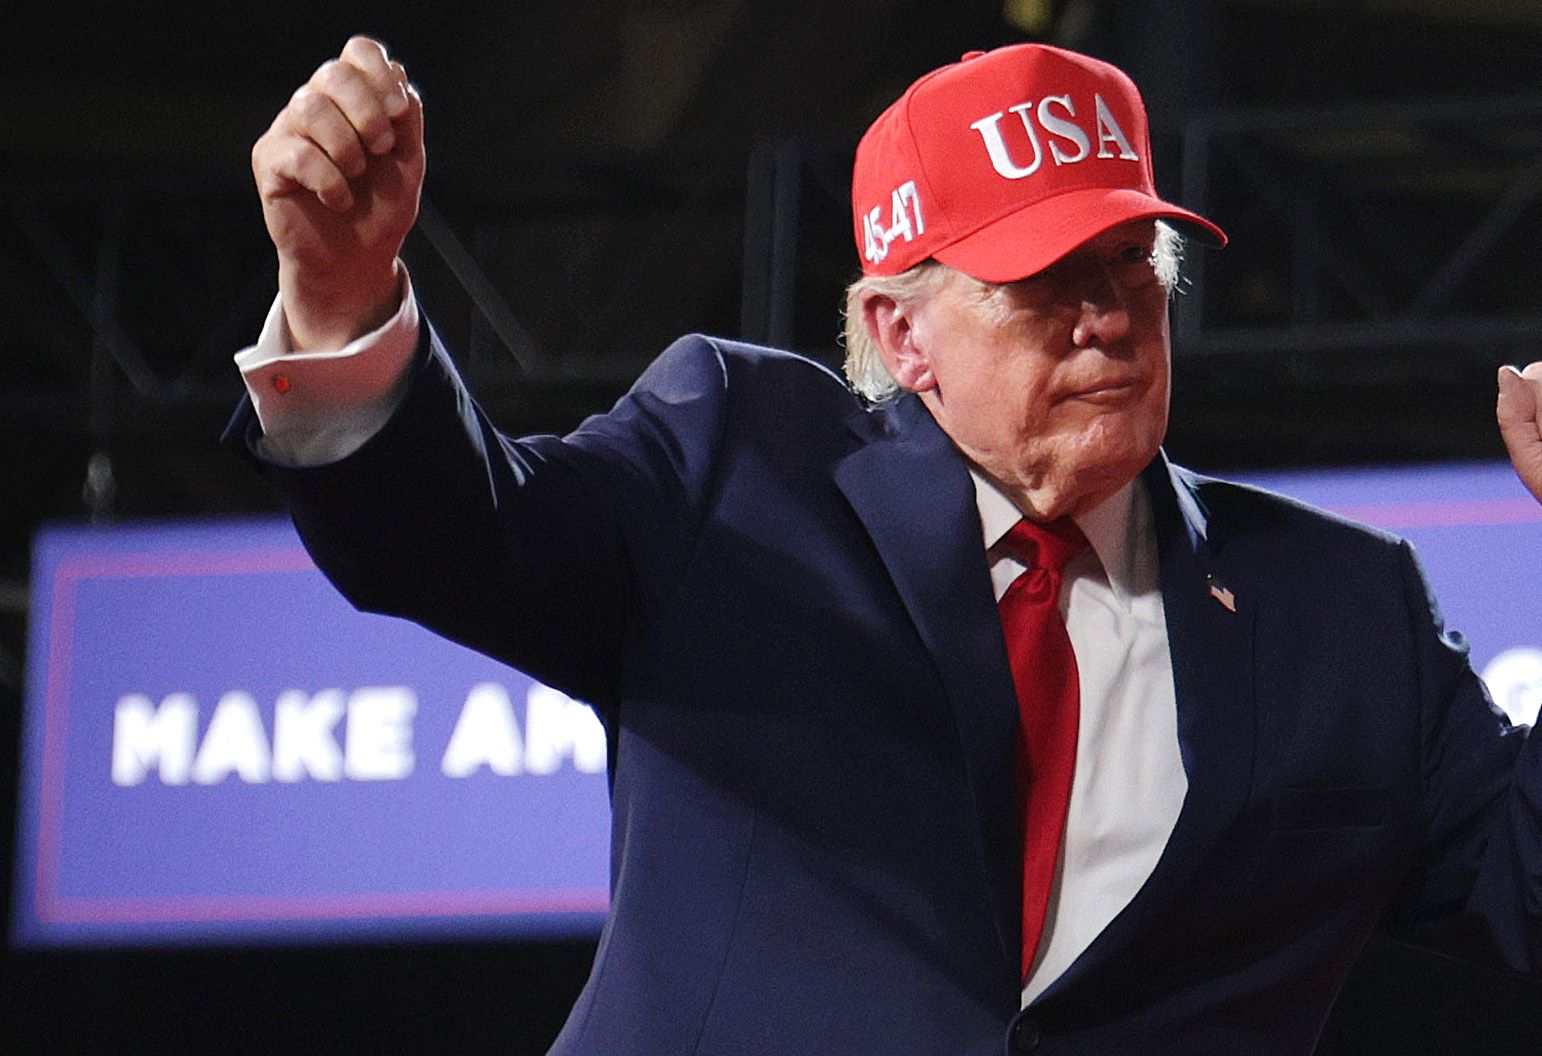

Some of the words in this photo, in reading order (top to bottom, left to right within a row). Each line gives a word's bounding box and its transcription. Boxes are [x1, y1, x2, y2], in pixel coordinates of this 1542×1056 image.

[970, 94, 1139, 179] USA
[863, 180, 925, 265] 45-47
[112, 686, 417, 785] MAKE
